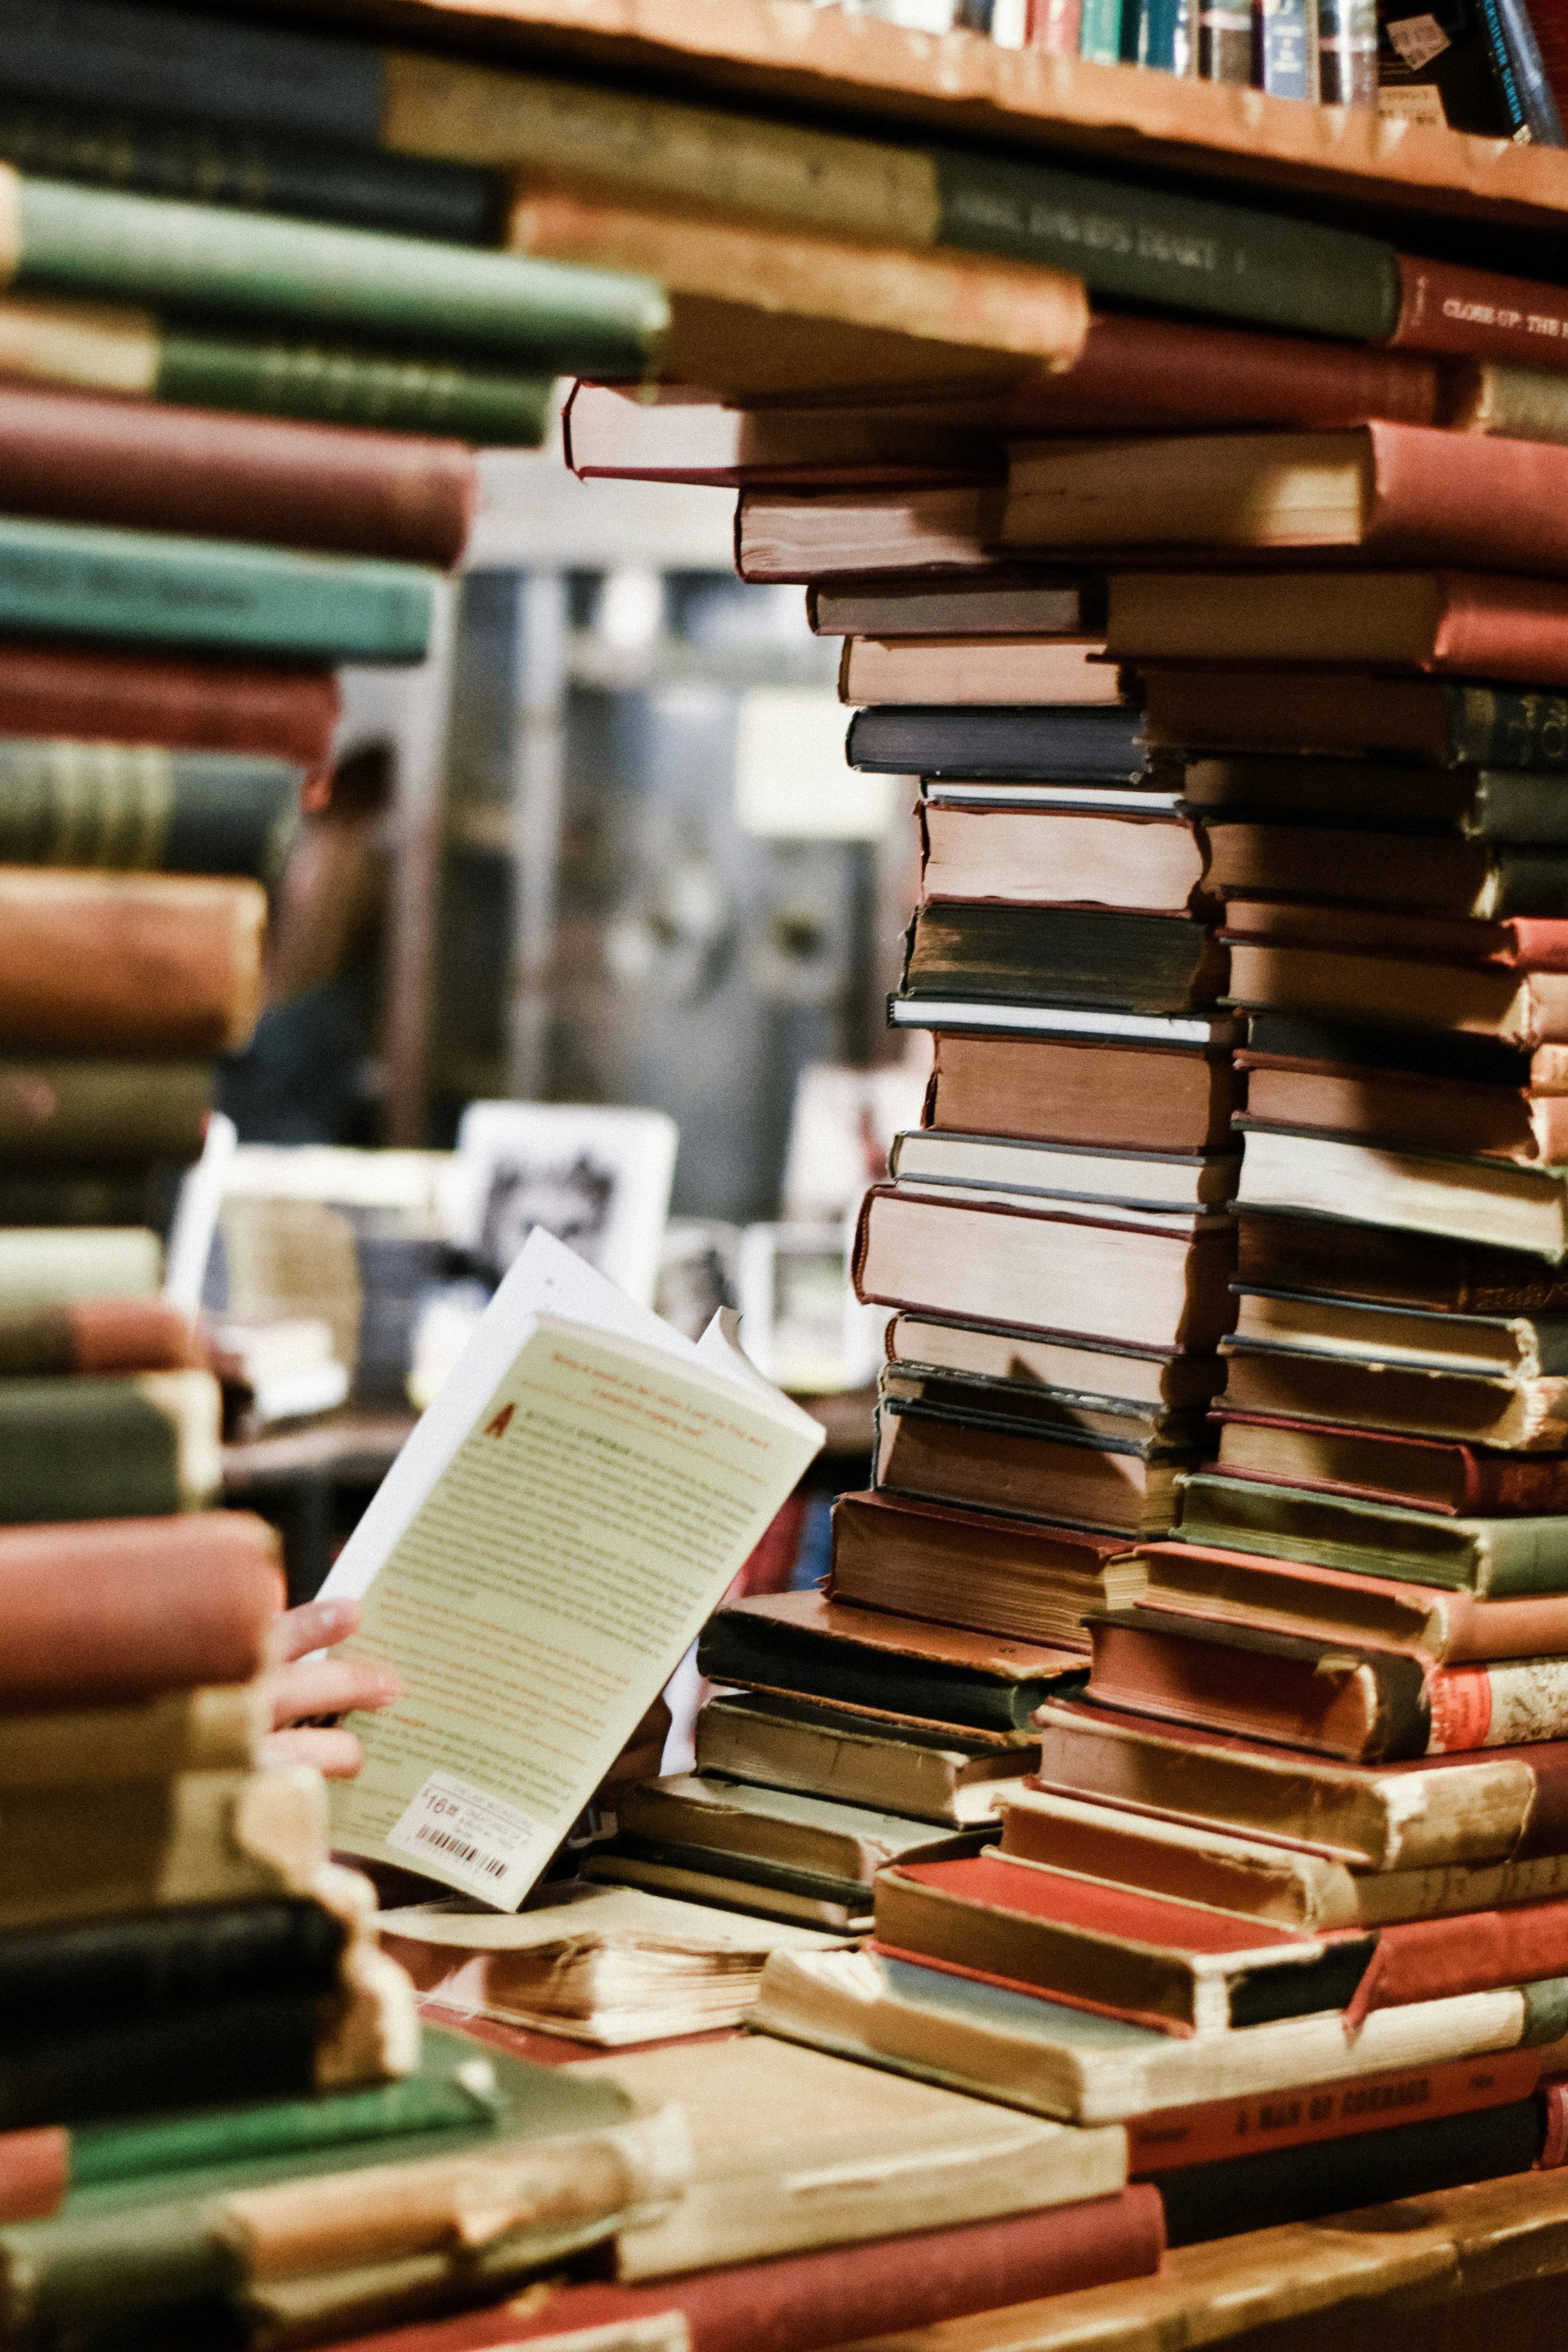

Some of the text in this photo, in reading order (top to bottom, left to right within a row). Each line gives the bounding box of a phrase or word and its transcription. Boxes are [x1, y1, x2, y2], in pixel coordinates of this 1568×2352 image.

[1502, 68, 1522, 124] SCREEN
[1442, 300, 1495, 324] CLOSE
[1497, 309, 1521, 328] UP
[1526, 315, 1558, 337] THE
